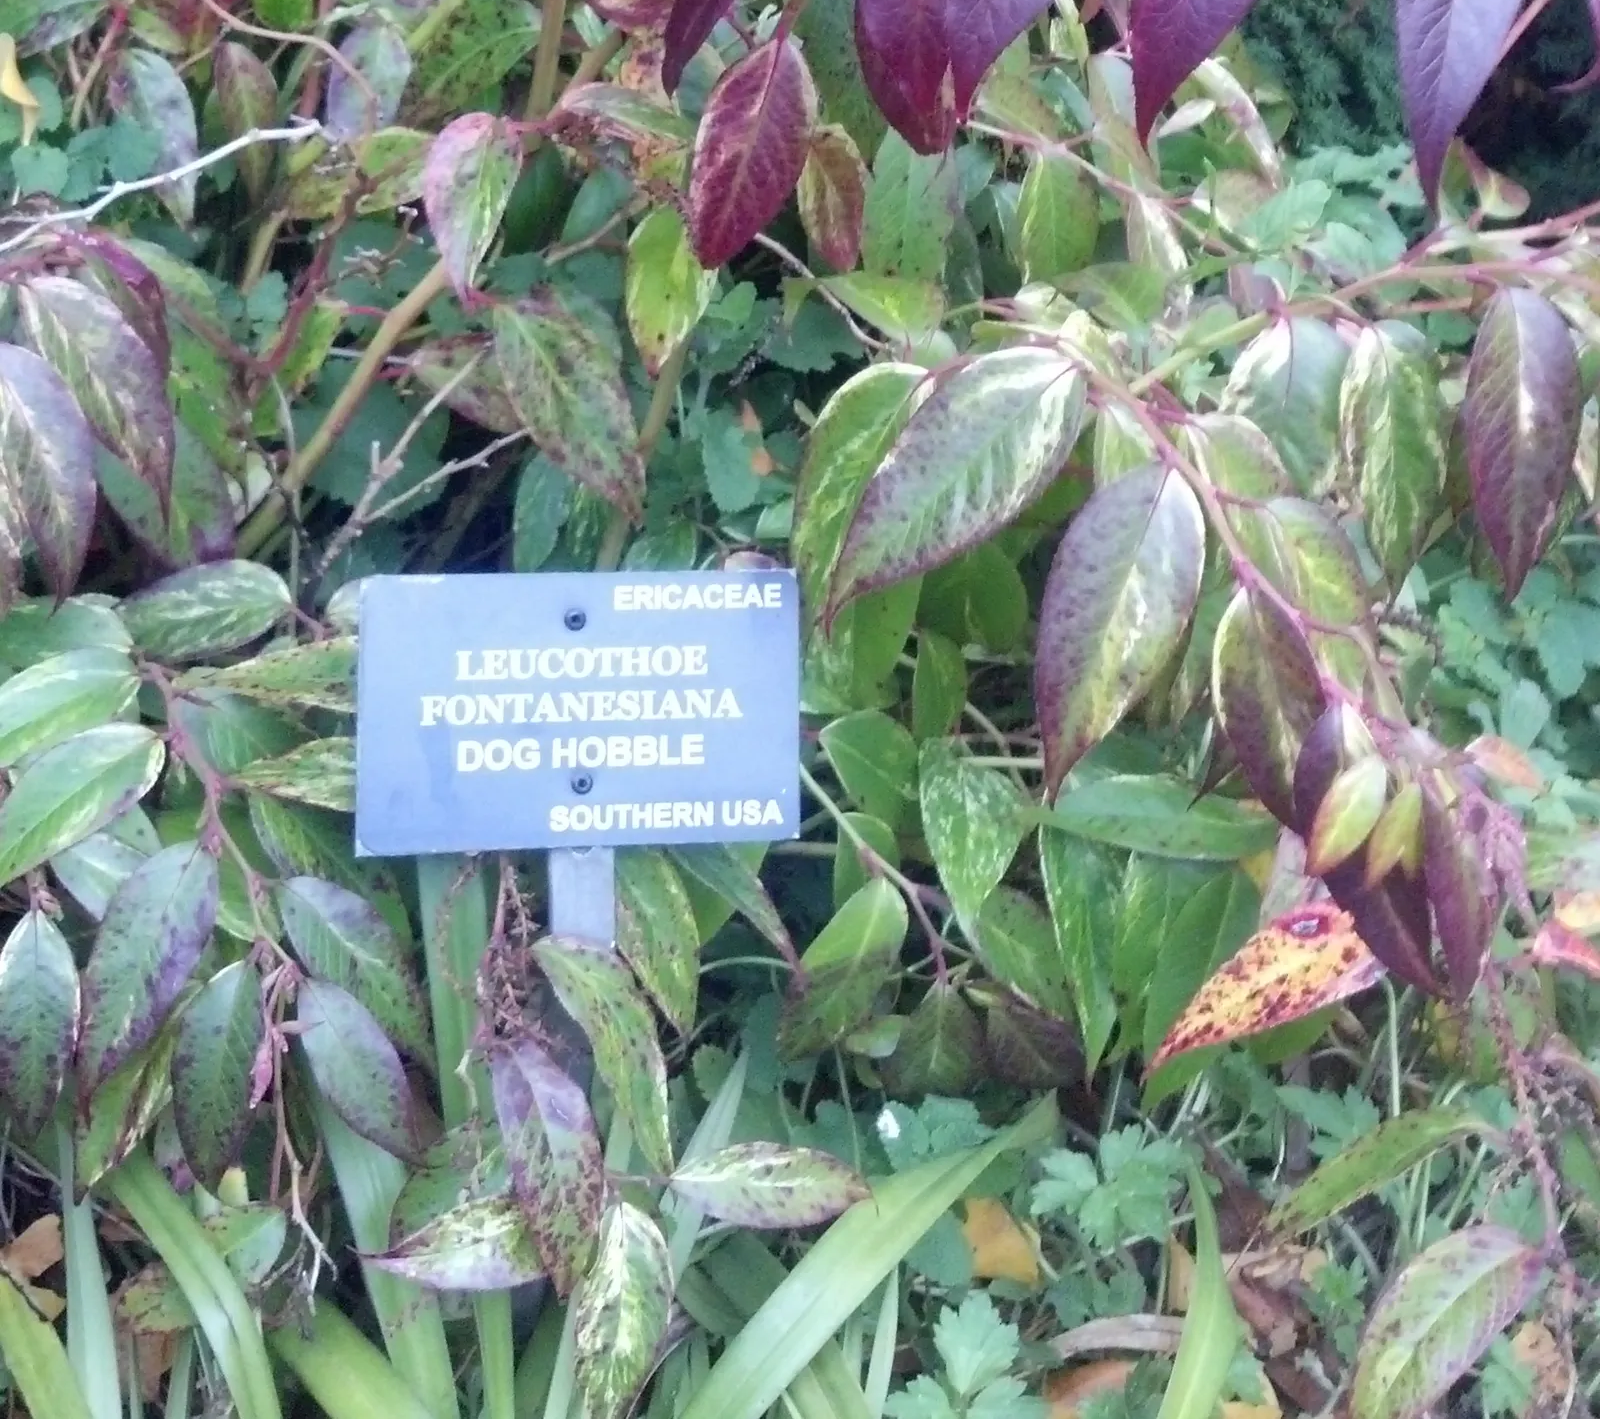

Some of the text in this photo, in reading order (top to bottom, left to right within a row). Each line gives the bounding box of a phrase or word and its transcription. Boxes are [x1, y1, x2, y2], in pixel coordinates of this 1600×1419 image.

[613, 583, 782, 611] ERICACEAE
[455, 645, 708, 681] LEUCOTHOE
[420, 688, 743, 727] FONTANESIANA
[456, 734, 705, 772] DOG HOBBLE
[549, 799, 784, 832] SOUTHERN USA
